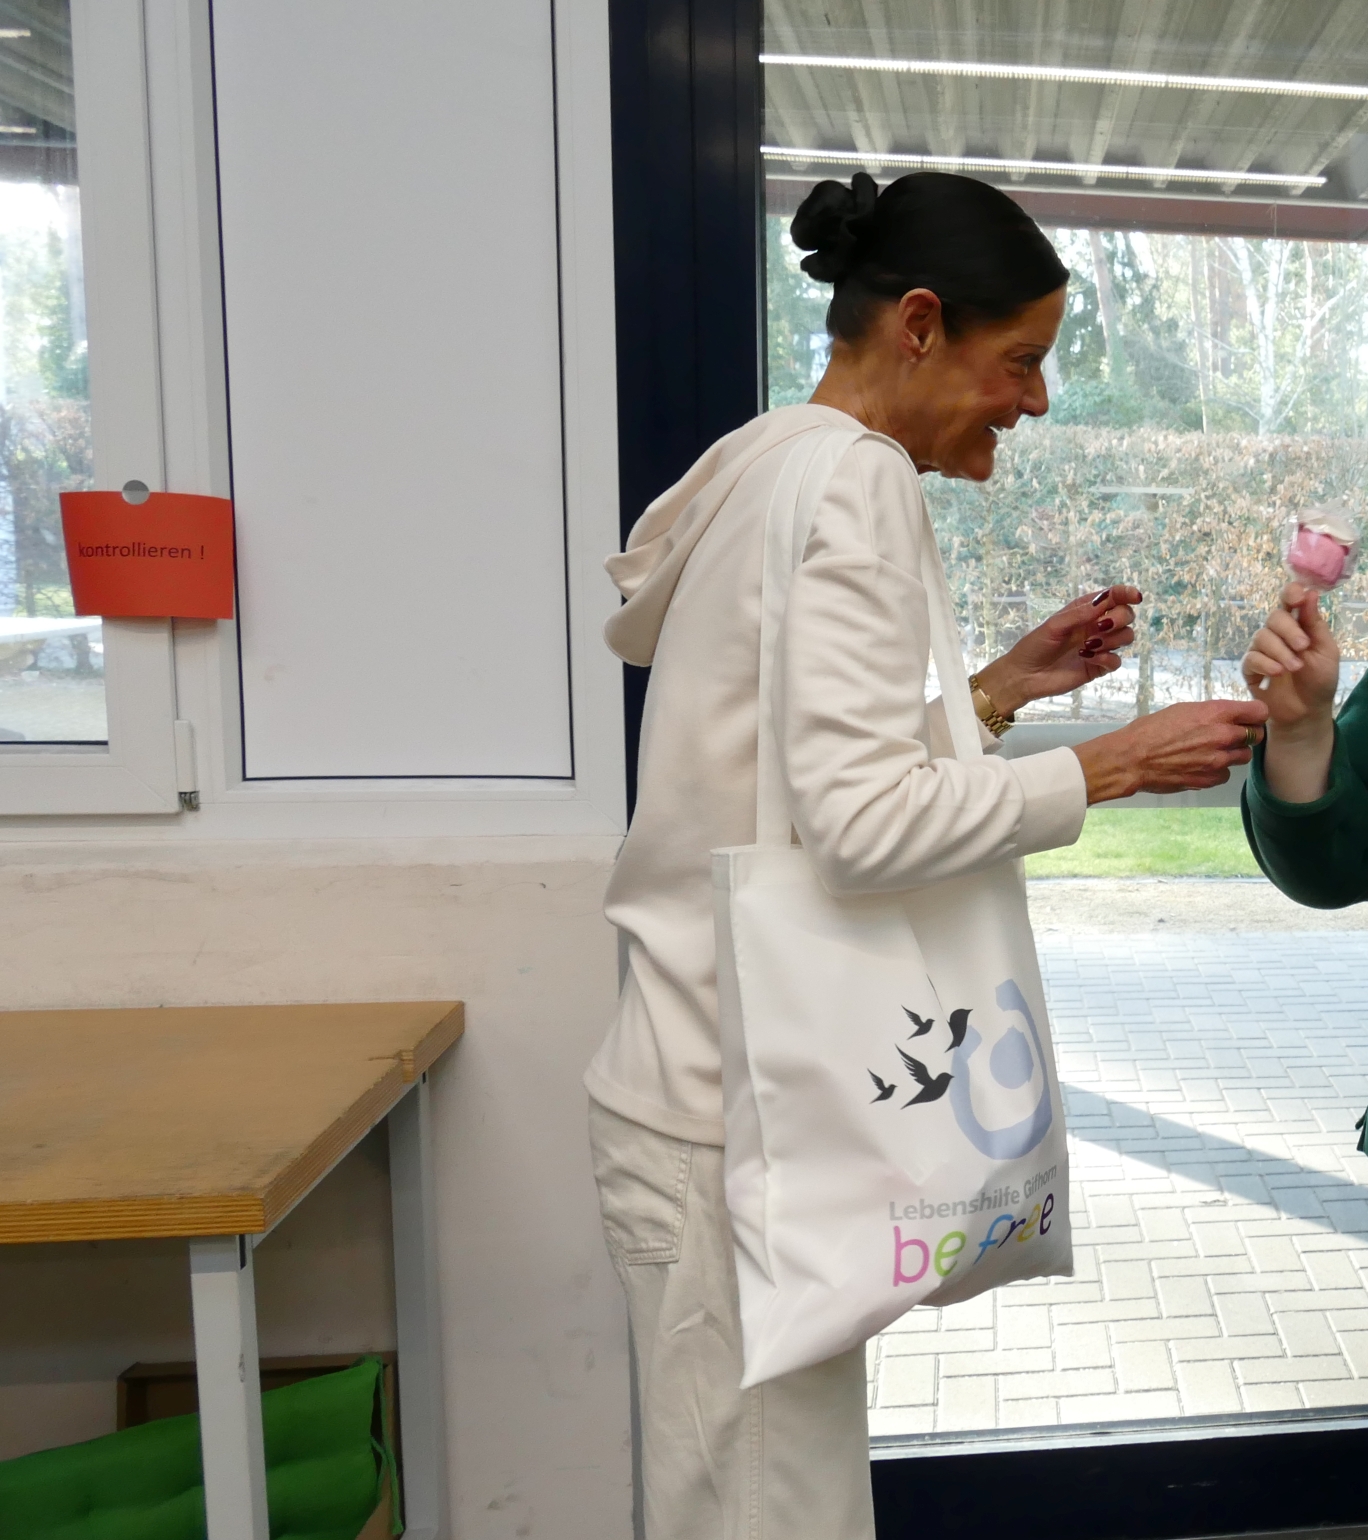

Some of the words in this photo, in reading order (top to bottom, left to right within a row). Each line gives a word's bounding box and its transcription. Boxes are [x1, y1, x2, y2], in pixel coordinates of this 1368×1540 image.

[78, 541, 192, 559] kontrollieren
[200, 545, 205, 560] !
[889, 1185, 1020, 1221] Lebenshilfe
[1023, 1164, 1057, 1199] Gifhorn
[893, 1225, 966, 1287] be
[973, 1193, 1054, 1265] free
